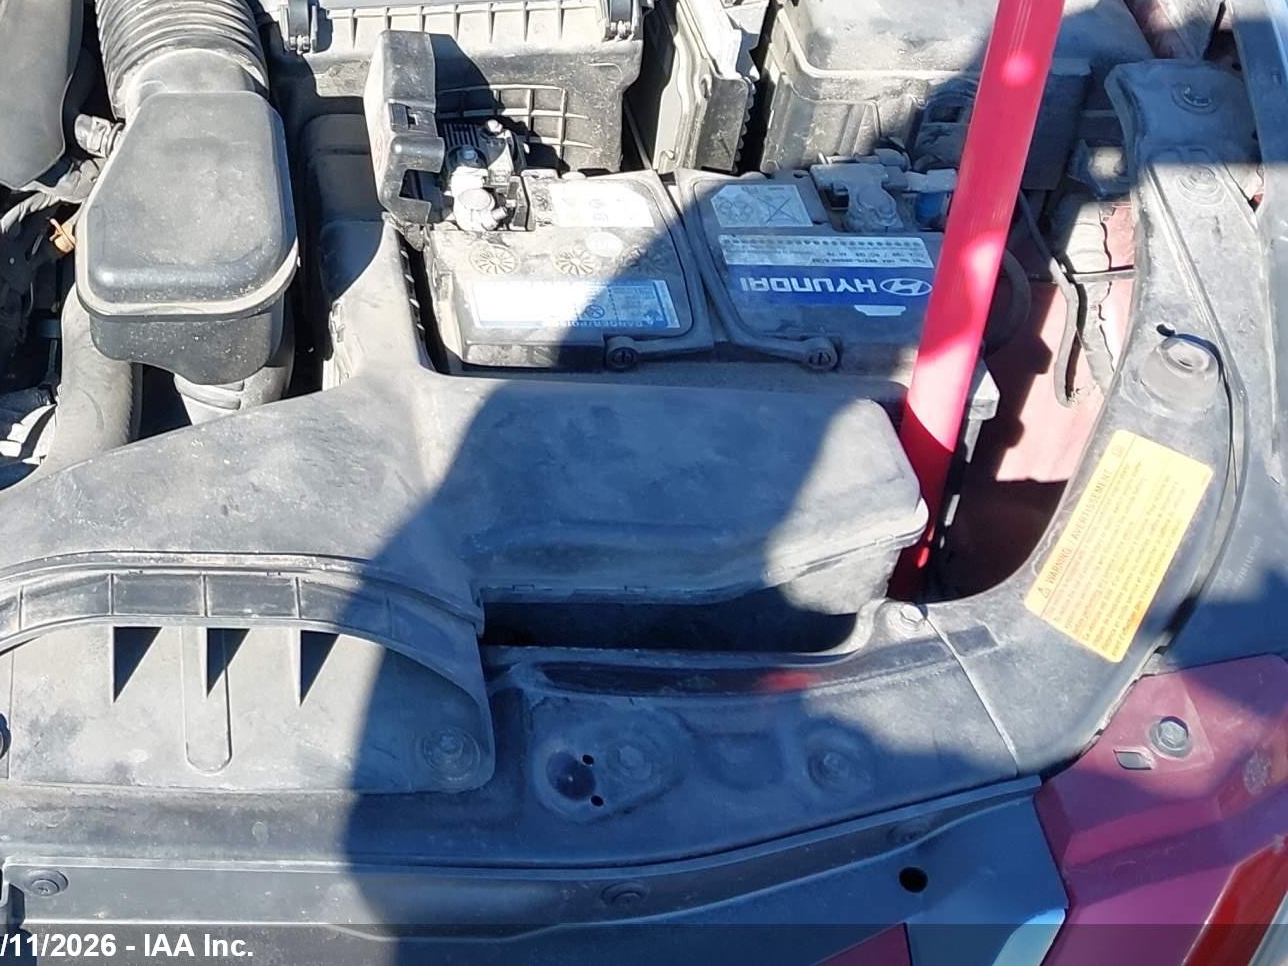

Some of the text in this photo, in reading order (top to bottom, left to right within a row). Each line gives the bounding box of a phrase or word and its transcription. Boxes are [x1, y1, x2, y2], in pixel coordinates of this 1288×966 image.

[740, 277, 878, 293] HYUNDAI
[1045, 548, 1073, 585] WARNING
[1070, 468, 1113, 541] AVERTISSEMENT
